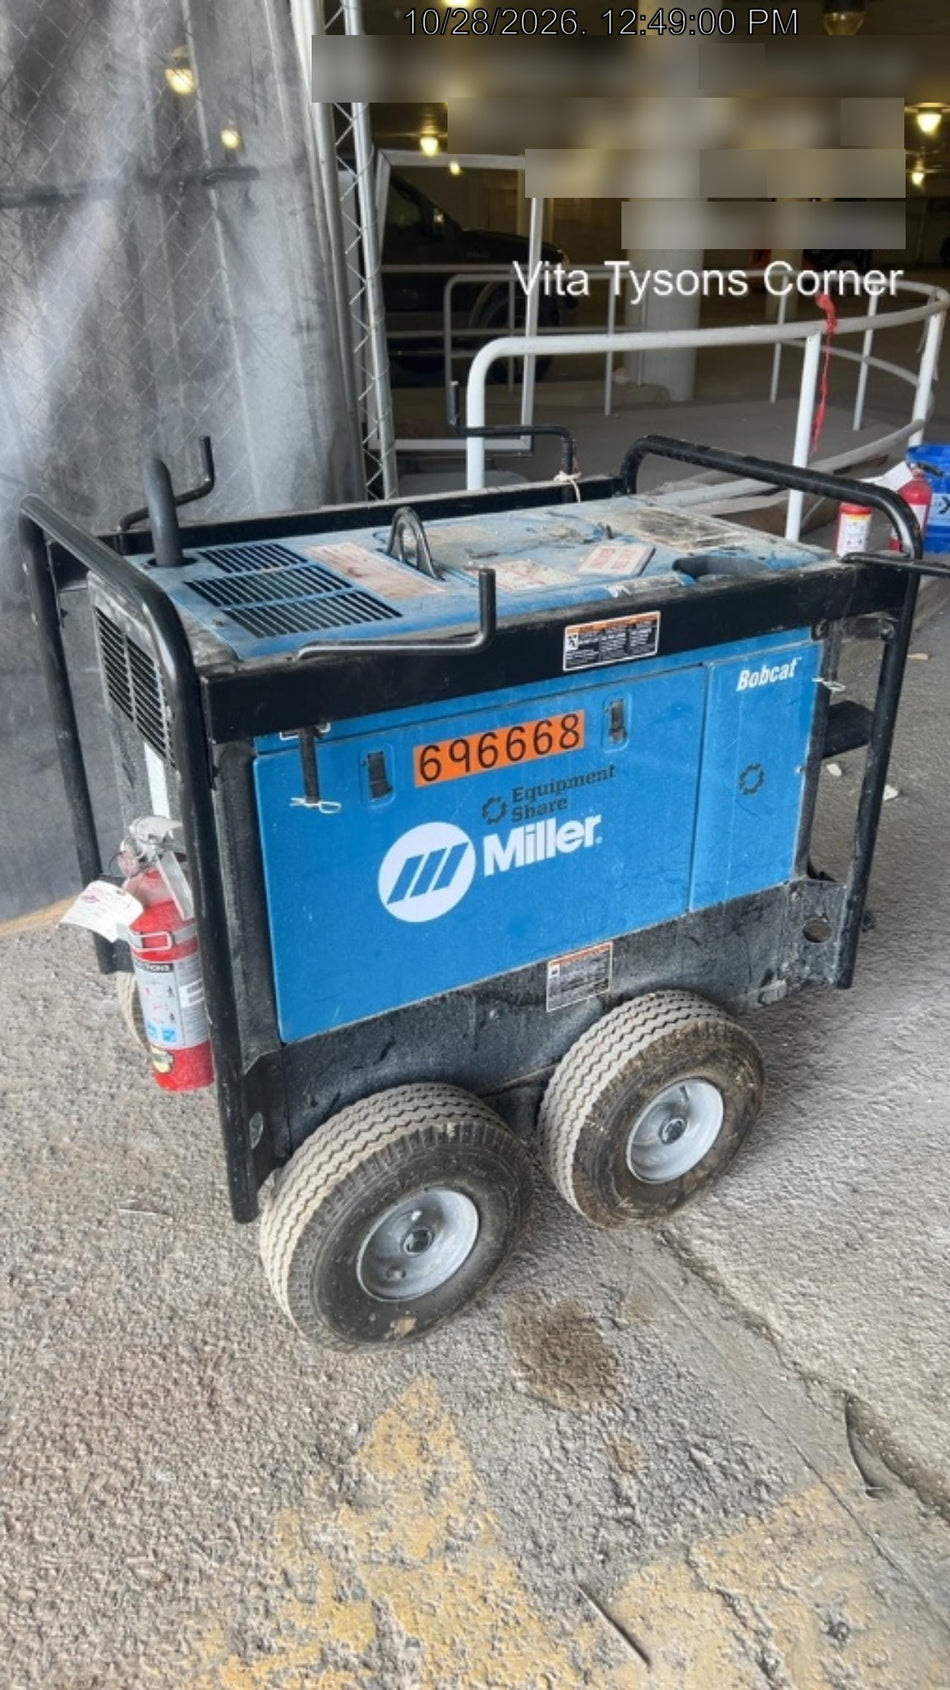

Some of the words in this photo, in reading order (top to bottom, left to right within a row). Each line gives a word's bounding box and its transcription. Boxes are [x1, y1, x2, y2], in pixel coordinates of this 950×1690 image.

[736, 657, 798, 692] Bobcat
[419, 713, 580, 782] 696668
[511, 764, 616, 803] Equipment
[511, 797, 568, 823] Share
[483, 814, 603, 878] Miller
